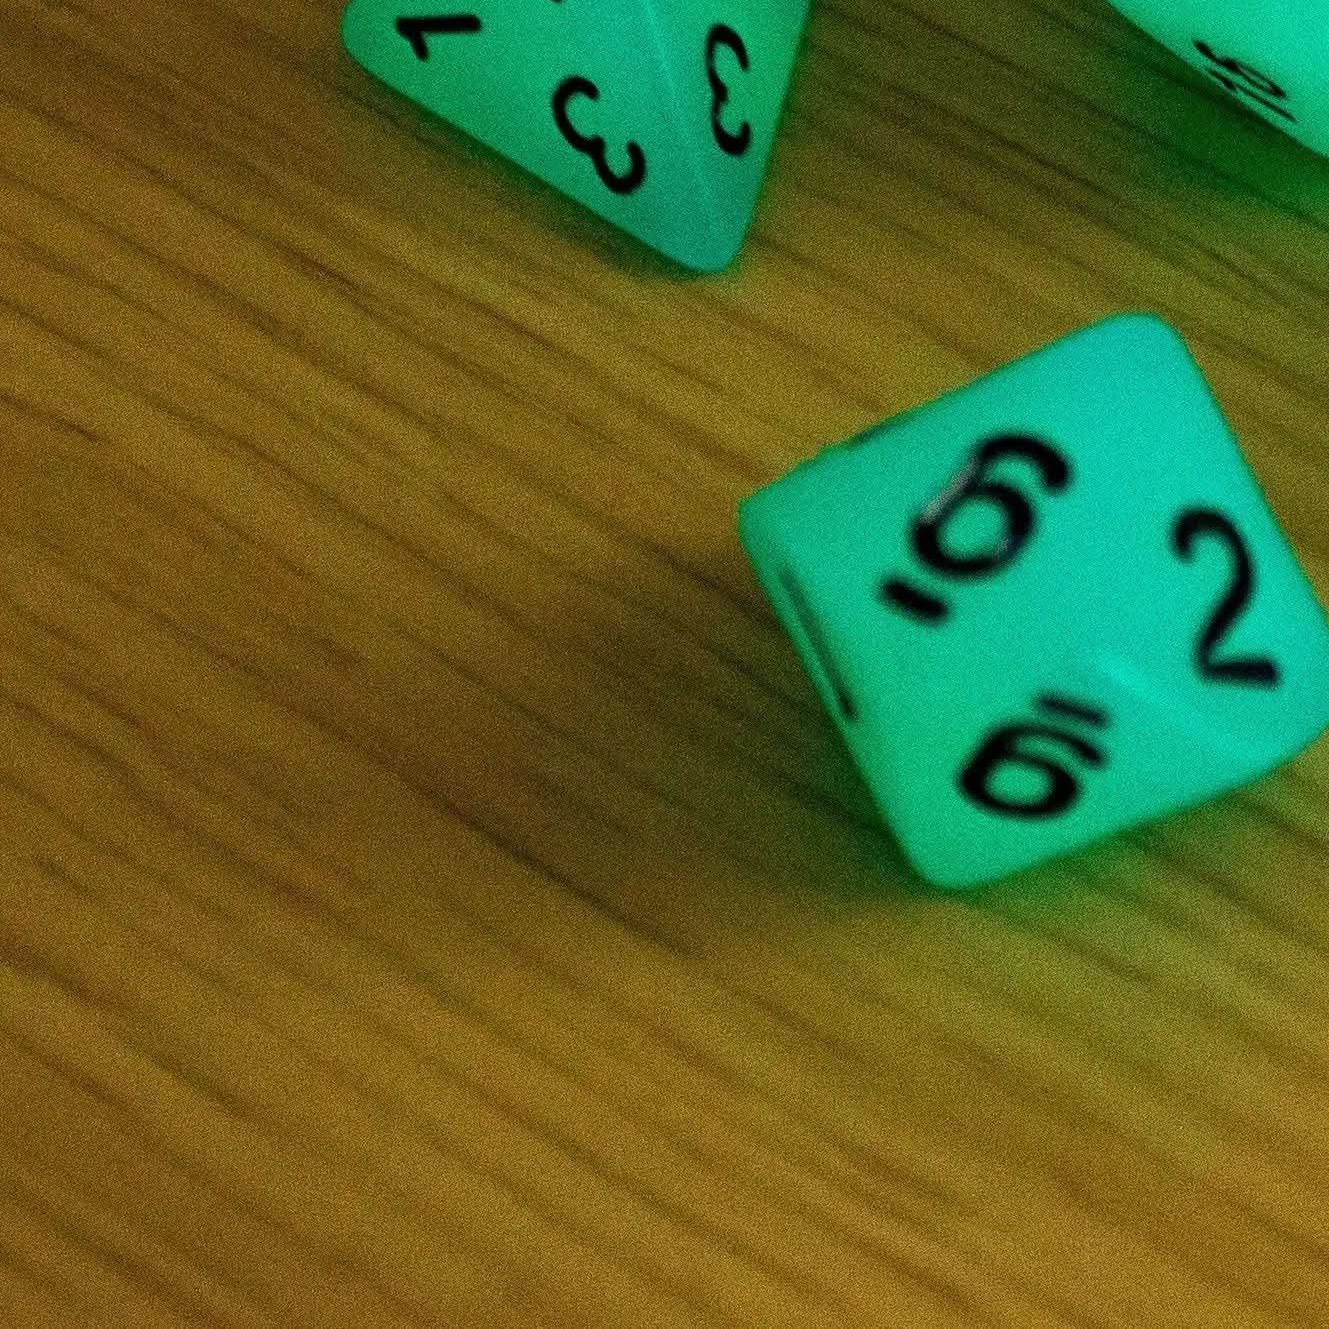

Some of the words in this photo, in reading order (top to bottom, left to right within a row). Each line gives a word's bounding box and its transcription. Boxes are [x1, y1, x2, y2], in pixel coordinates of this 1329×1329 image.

[395, 14, 482, 61] 1
[705, 24, 752, 158] 3
[552, 75, 647, 195] 3
[1168, 505, 1281, 691] 2
